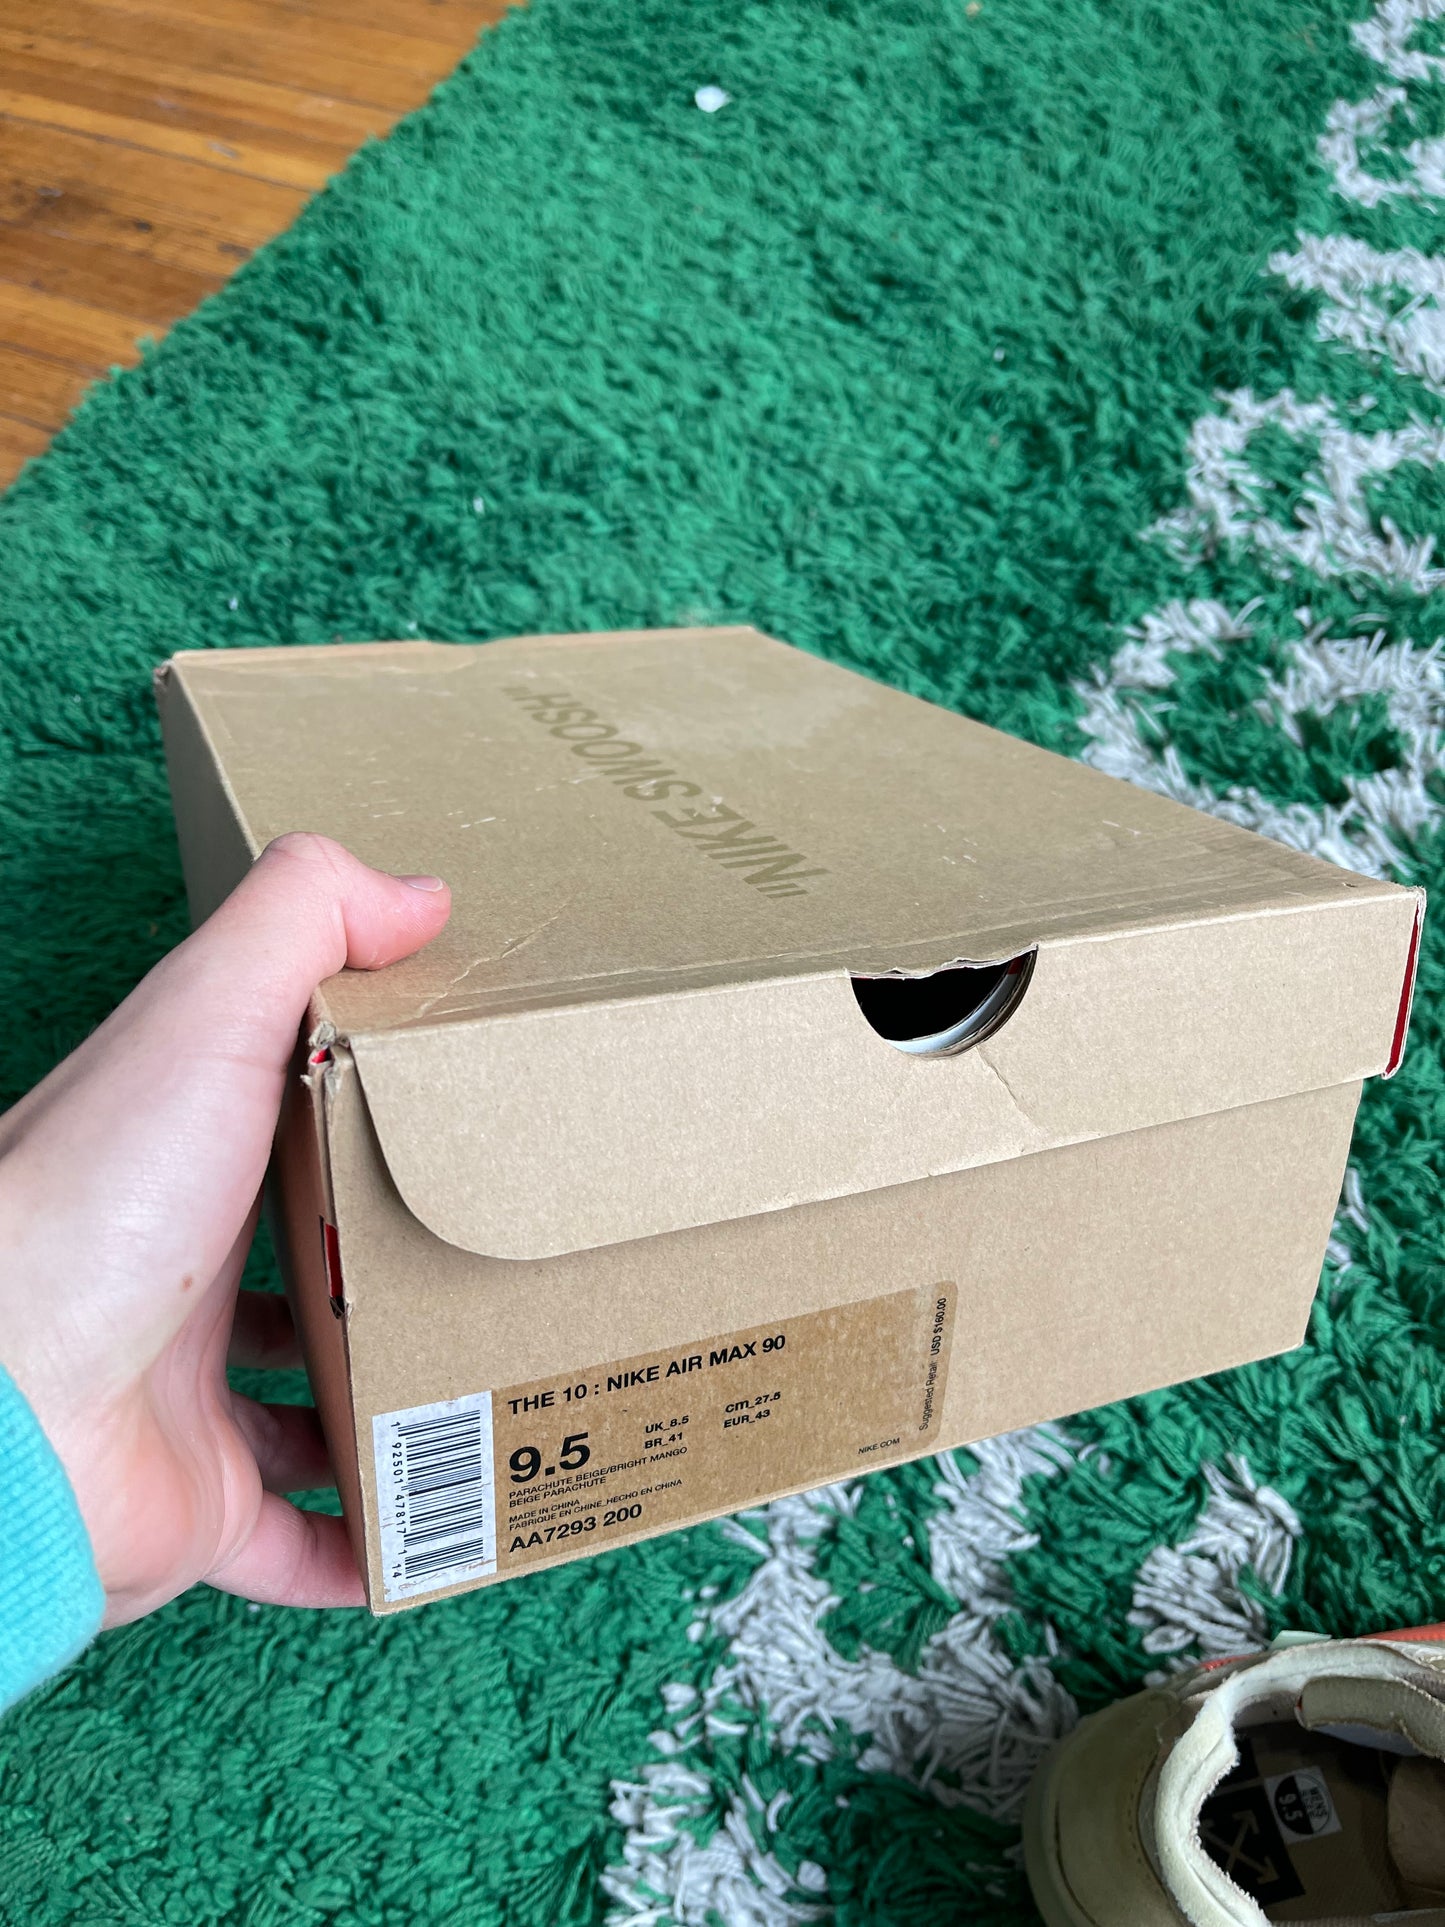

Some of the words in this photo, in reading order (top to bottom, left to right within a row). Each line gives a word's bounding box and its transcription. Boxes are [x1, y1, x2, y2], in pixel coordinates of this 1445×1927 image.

[933, 1298, 947, 1335] $160.00
[930, 1335, 942, 1356] USD
[508, 1391, 555, 1415] THE
[563, 1383, 587, 1402] 10
[607, 1365, 660, 1392] NIKE
[666, 1355, 702, 1377] AIR
[709, 1341, 757, 1367] MAX
[762, 1335, 786, 1353] 90
[723, 1409, 771, 1428] EUR_43
[725, 1391, 781, 1413] cm_27.5
[919, 1386, 935, 1431] Suggested
[644, 1432, 683, 1450] BR_41
[645, 1415, 690, 1434] UK_8.5
[392, 1441, 403, 1484] 92501
[509, 1432, 591, 1483] 9.5
[509, 1477, 573, 1499] PARACHUTE
[576, 1457, 647, 1482] BEIGE/BRIGHT
[650, 1446, 687, 1463] MANGO
[509, 1493, 541, 1508] BEIGE
[543, 1476, 607, 1499] PARACHUTE
[509, 1513, 557, 1531] FABRIQUE
[559, 1509, 572, 1517] EN
[641, 1487, 653, 1496] EN
[654, 1479, 683, 1492] CHINA
[395, 1493, 407, 1534] 47817
[509, 1511, 537, 1523] MADE
[551, 1499, 580, 1512] CHINA
[509, 1516, 596, 1552] AA7293
[603, 1503, 642, 1527] 200
[1279, 1793, 1304, 1821] 9.5
